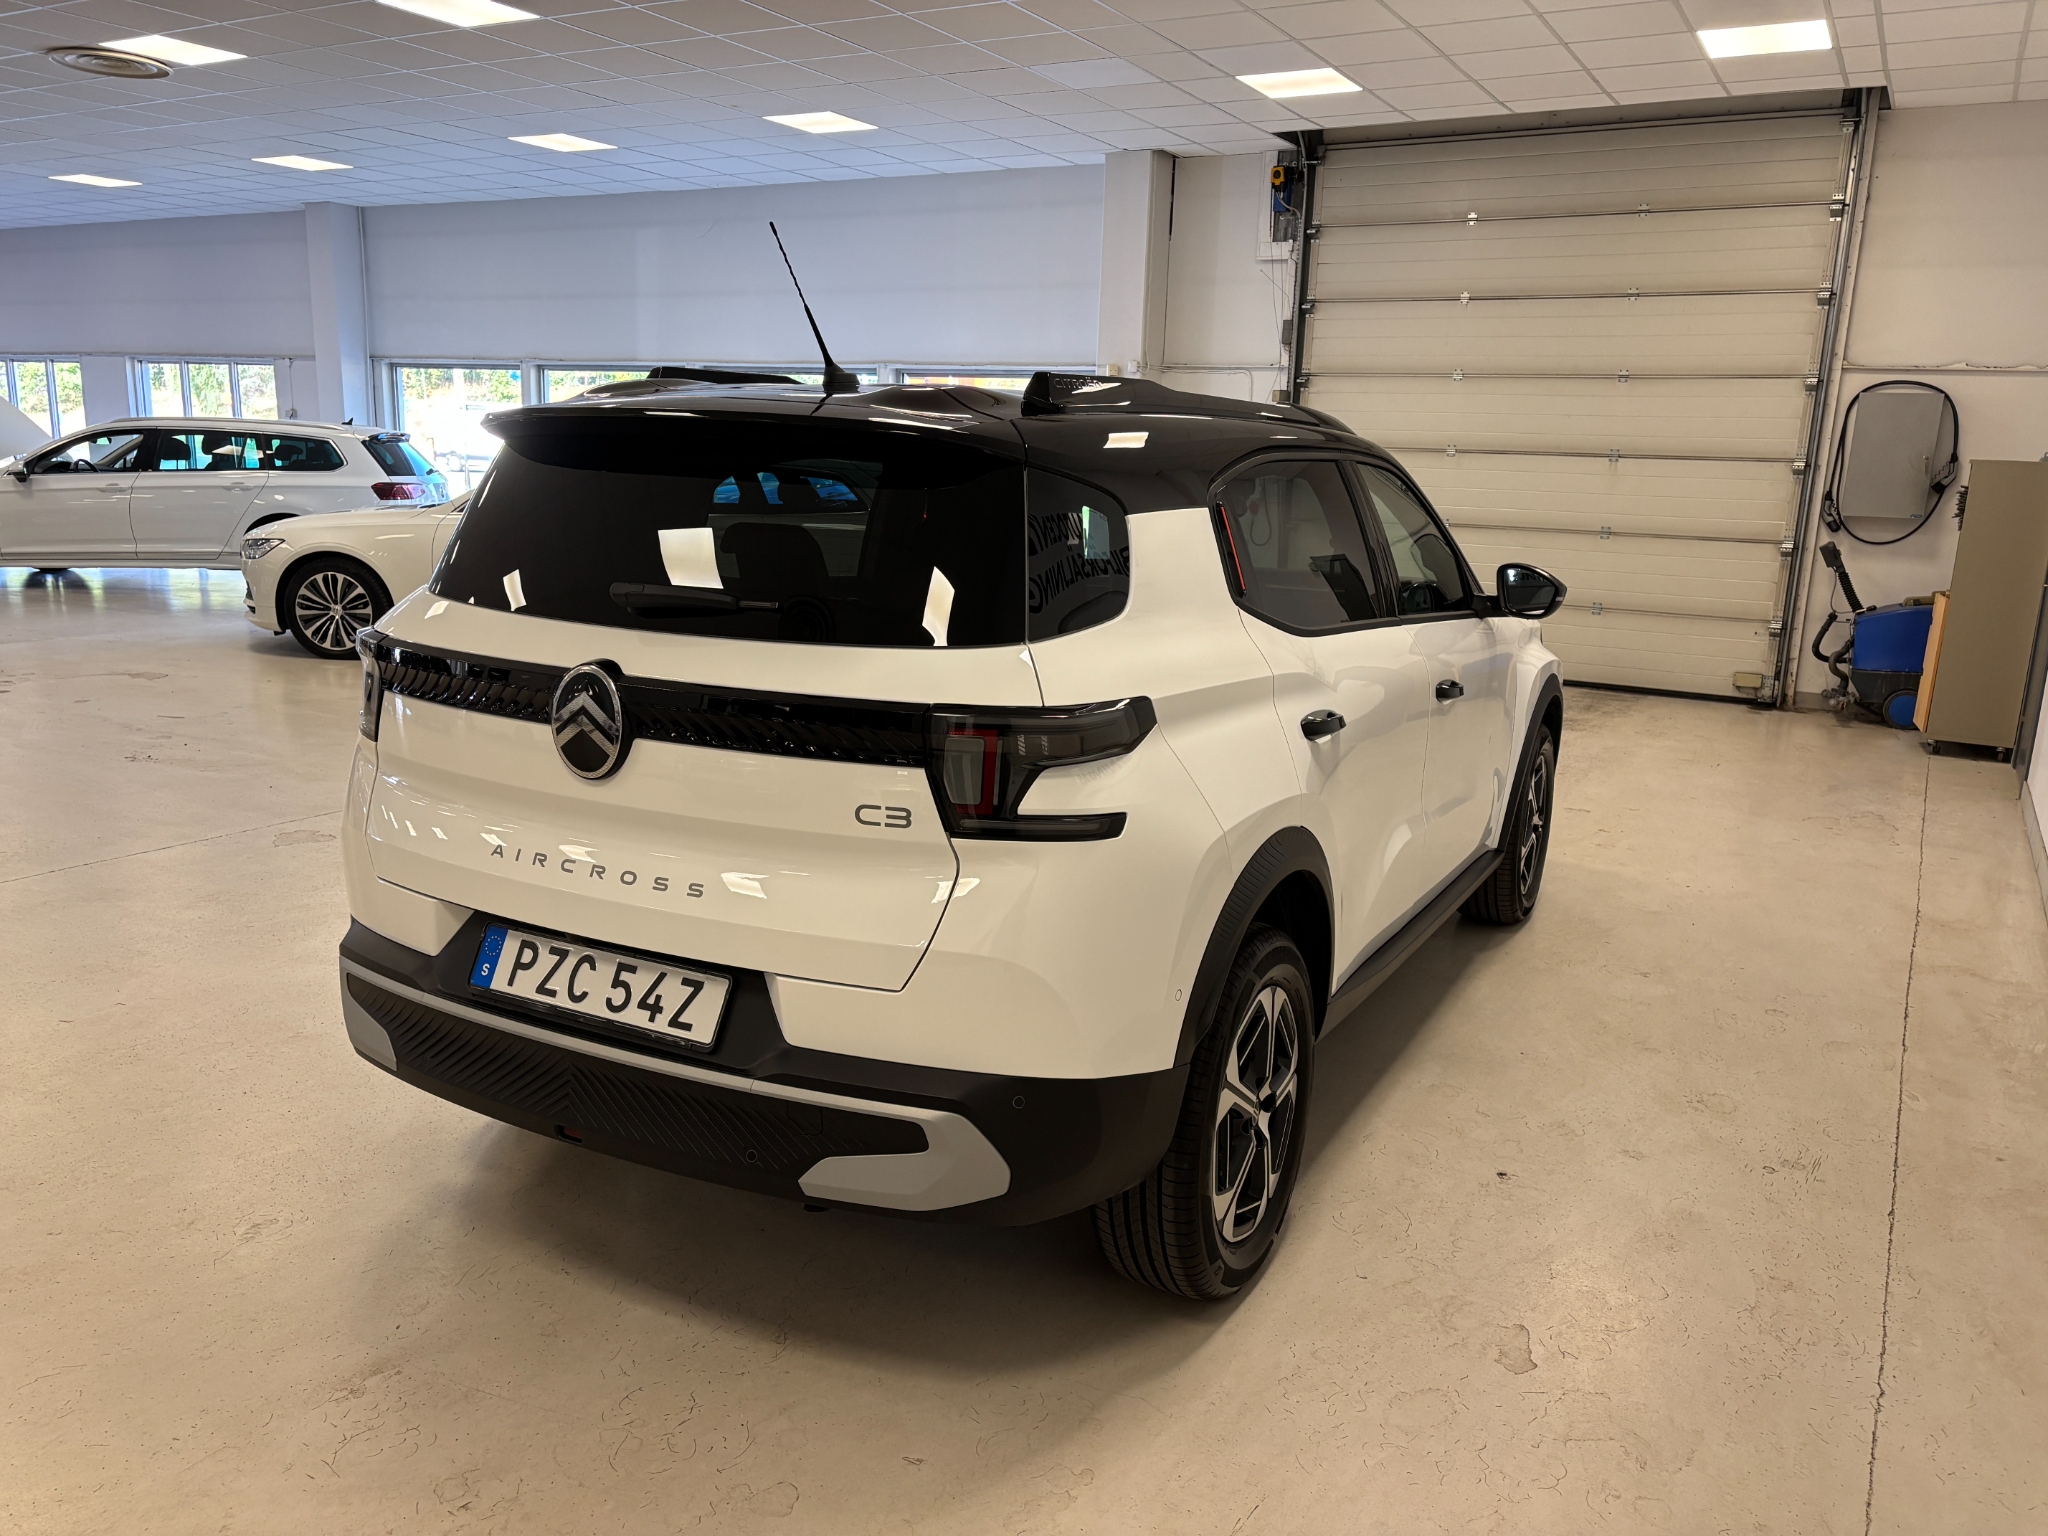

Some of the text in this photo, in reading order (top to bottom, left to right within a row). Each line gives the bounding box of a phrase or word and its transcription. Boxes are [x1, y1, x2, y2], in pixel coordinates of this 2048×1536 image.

[854, 803, 912, 829] C3
[490, 844, 705, 899] AIRCROSS
[480, 963, 490, 976] S
[507, 939, 705, 1032] PZC 54Z
